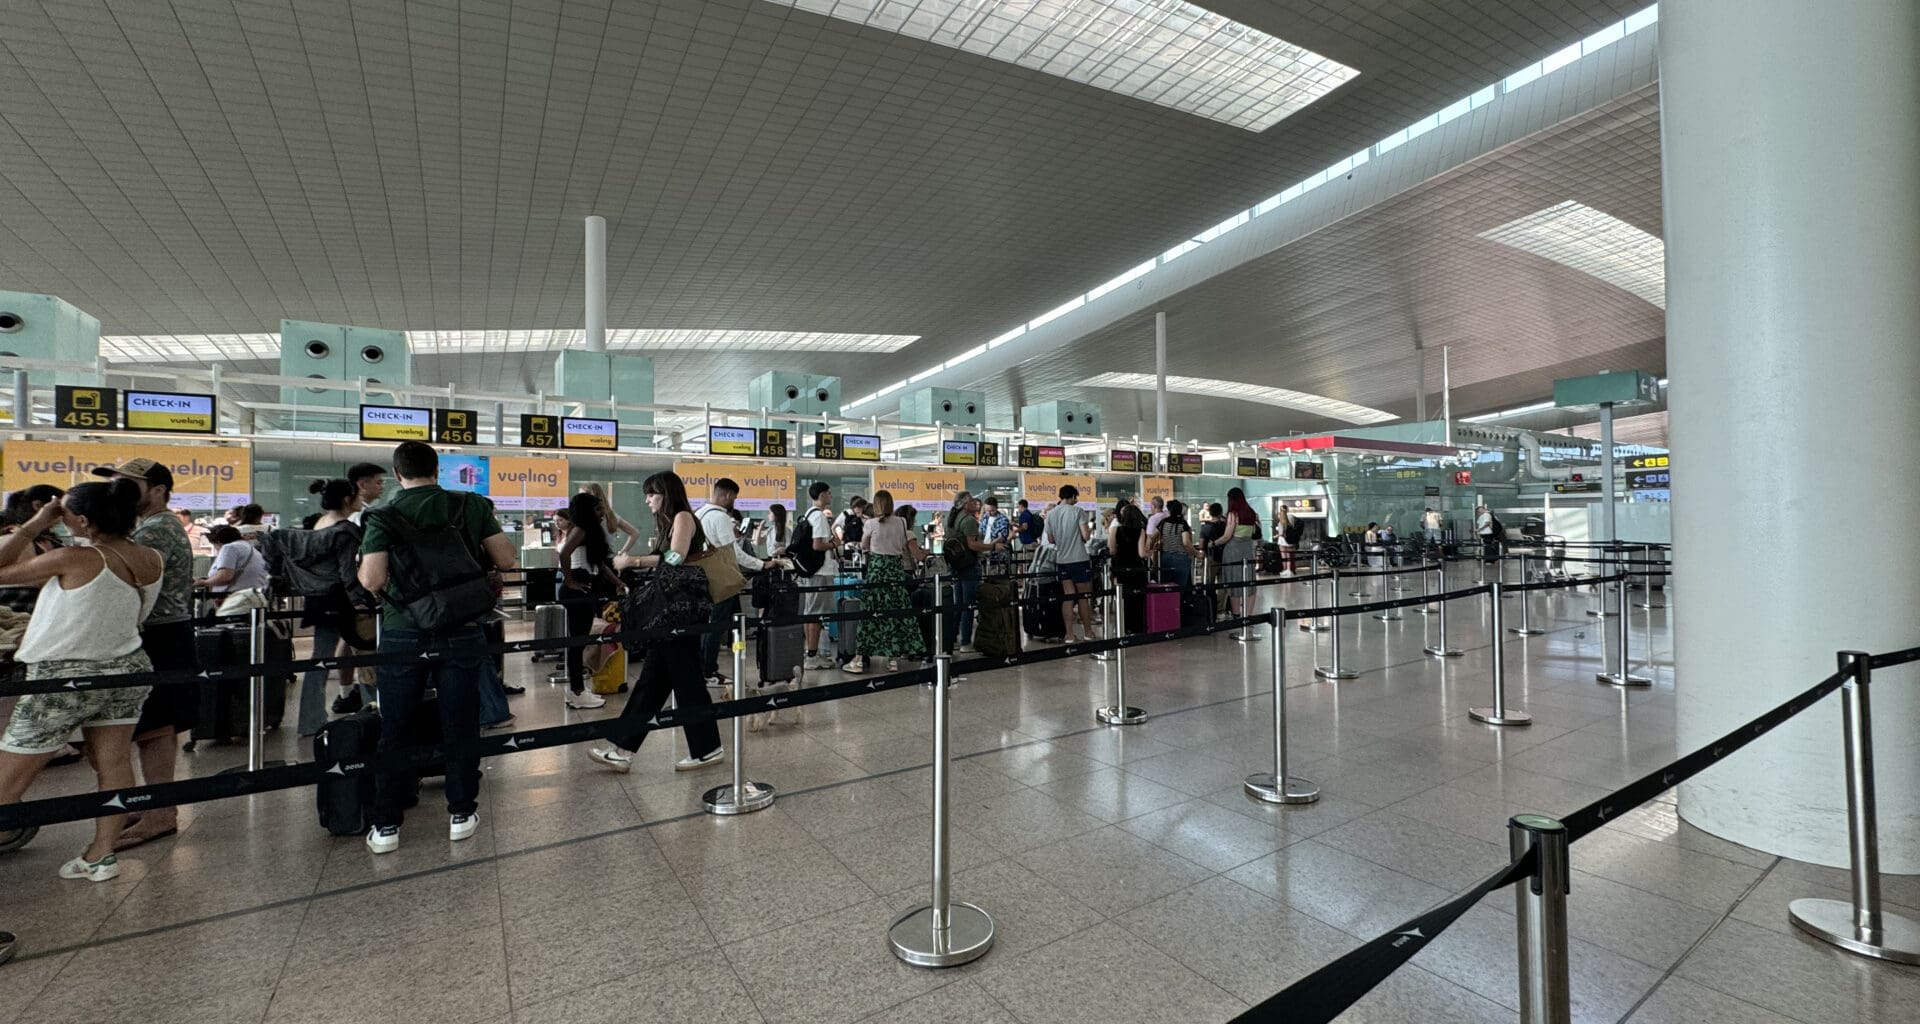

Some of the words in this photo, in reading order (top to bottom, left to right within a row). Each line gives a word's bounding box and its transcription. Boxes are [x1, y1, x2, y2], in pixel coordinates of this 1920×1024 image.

[133, 398, 191, 409] CHECK-IN
[63, 412, 110, 427] 455
[367, 411, 413, 420] CHECK-IN
[170, 417, 205, 426] vueling
[567, 423, 603, 431] CHECK-IN
[396, 427, 423, 436] vueling
[441, 430, 473, 442] 456
[526, 434, 553, 446] 457
[762, 445, 784, 455] 458
[819, 448, 838, 457] 459
[980, 456, 997, 465] 460
[171, 459, 234, 481] eling
[498, 469, 557, 487] vueling
[682, 473, 720, 485] vueli
[744, 475, 787, 489] vueling
[879, 479, 915, 492] vueling
[1028, 482, 1057, 494] vueling
[344, 762, 364, 771] aena
[126, 794, 152, 803] aena
